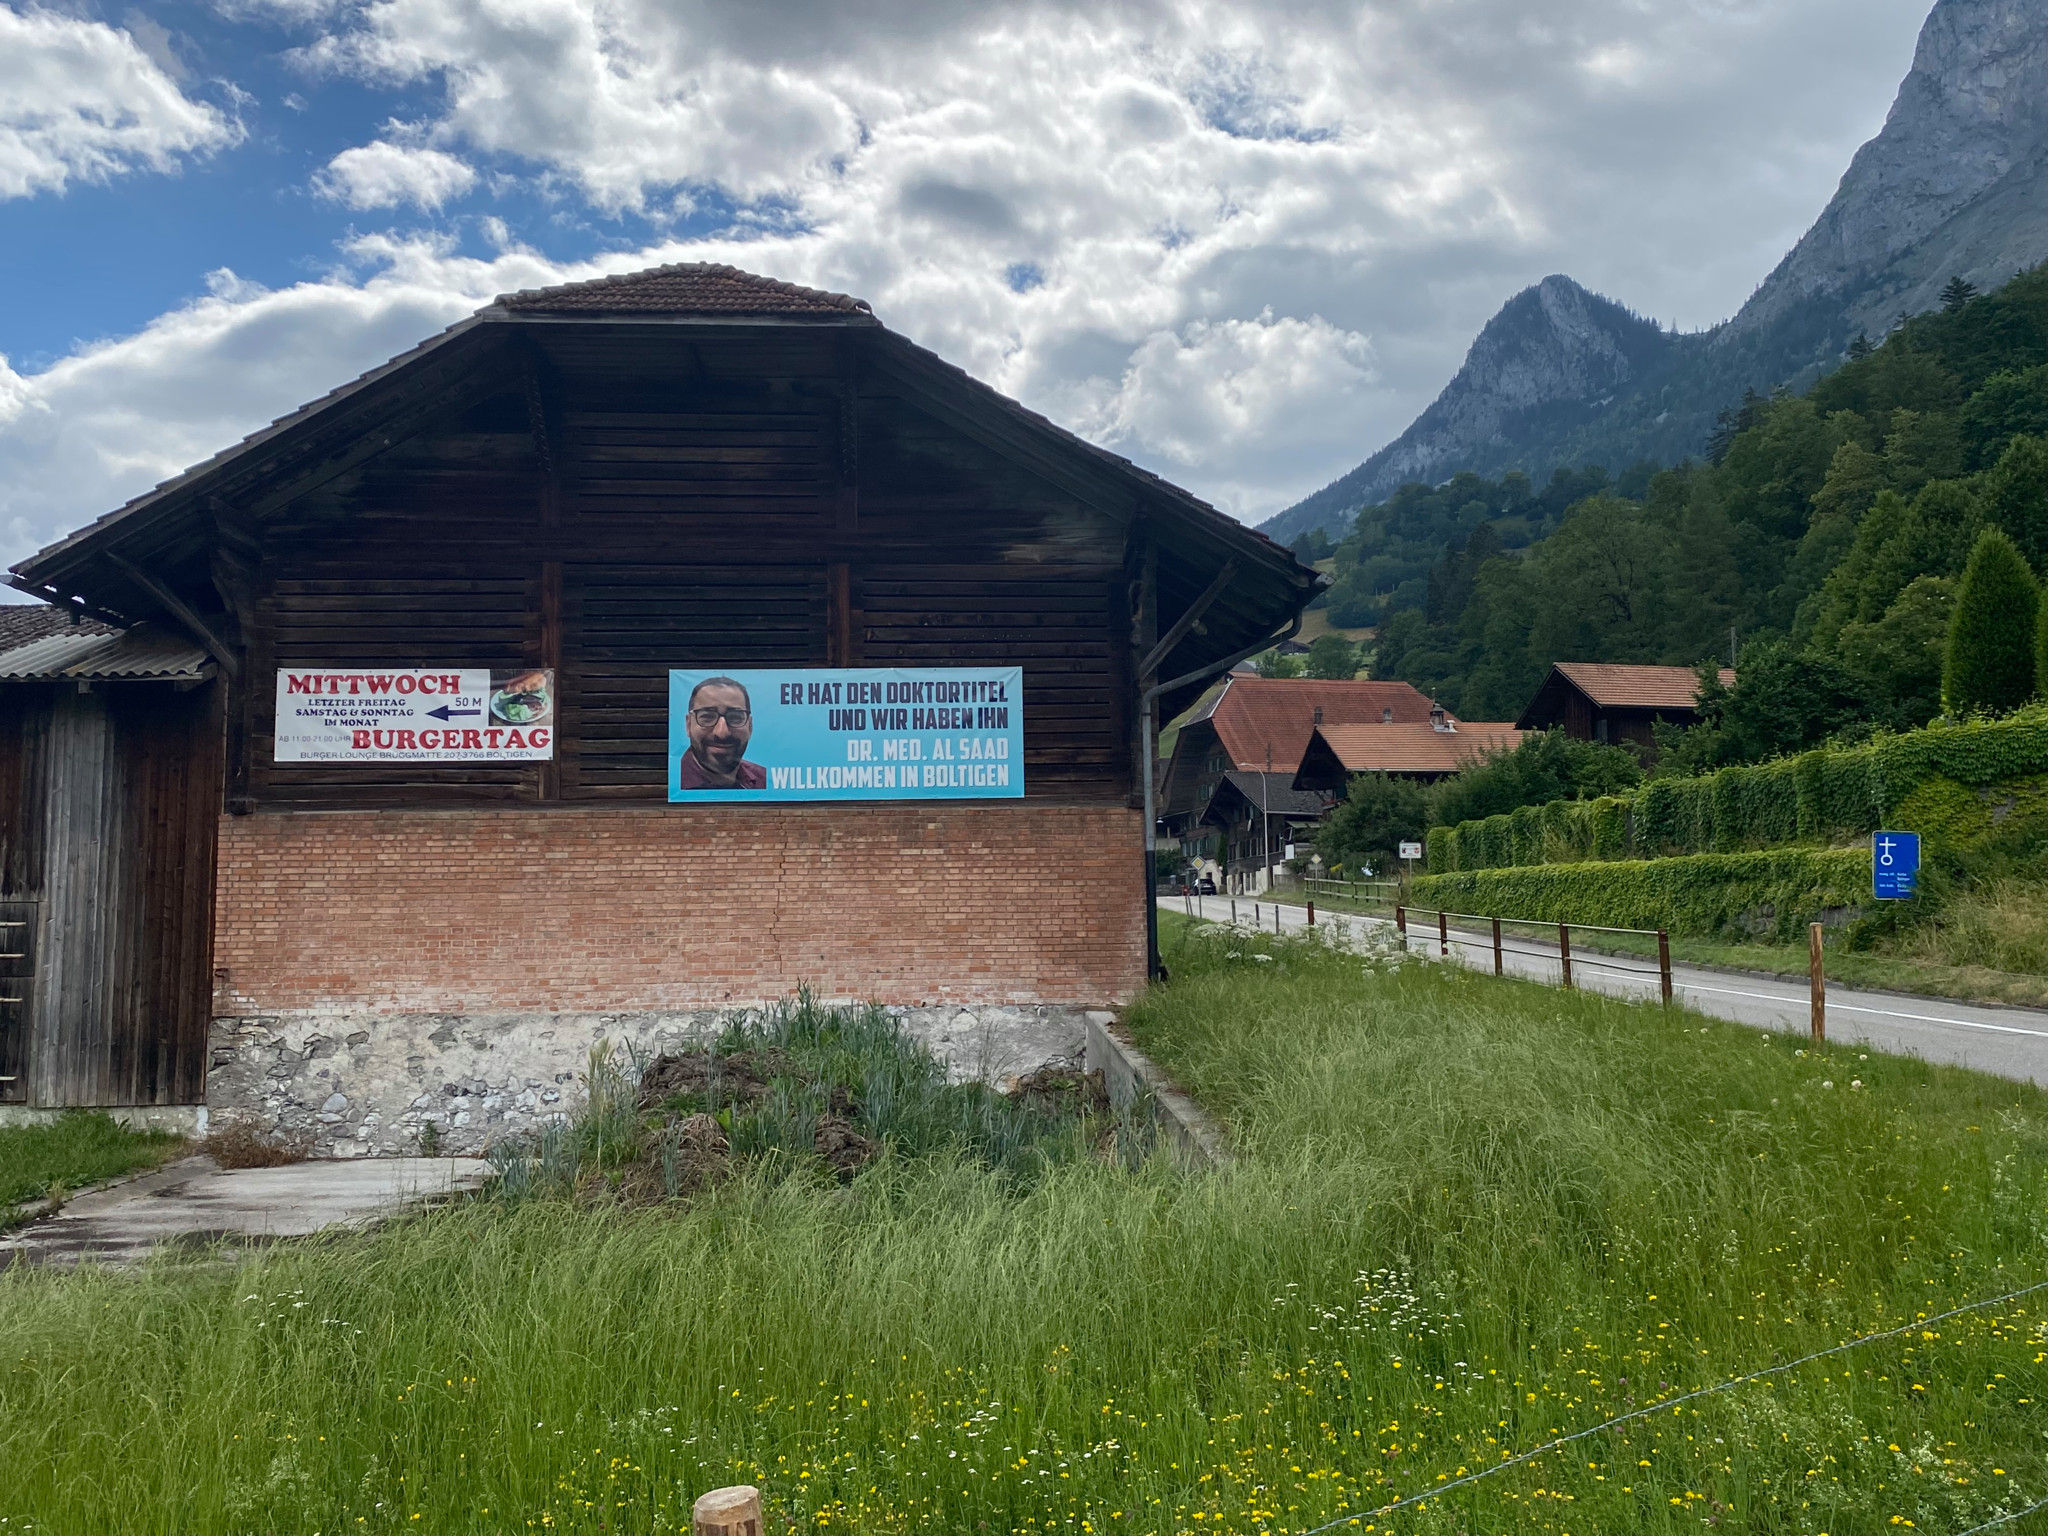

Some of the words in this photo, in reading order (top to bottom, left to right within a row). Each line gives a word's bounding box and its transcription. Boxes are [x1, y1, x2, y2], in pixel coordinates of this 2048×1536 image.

[287, 674, 461, 694] MITTWOCH
[780, 682, 803, 705] ER
[808, 681, 842, 705] HAT
[847, 681, 882, 704] DEN
[886, 680, 1009, 704] DOKTORTITEL
[308, 698, 355, 706] LETZTER
[358, 698, 406, 706] FREITAG
[455, 697, 468, 706] 50
[472, 697, 482, 706] M
[828, 708, 866, 731] UND
[871, 708, 908, 730] WIR
[912, 707, 973, 730] HABEN
[977, 707, 1009, 729] IHN
[352, 729, 550, 749] BURGERTAG
[847, 739, 878, 762] DR.
[883, 739, 928, 762] MED.
[932, 738, 955, 761] AL
[959, 737, 1009, 760] SAAD
[771, 765, 896, 790] WILLKOMMEN
[900, 765, 919, 788] IN
[923, 764, 1010, 788] BOLTIGEN
